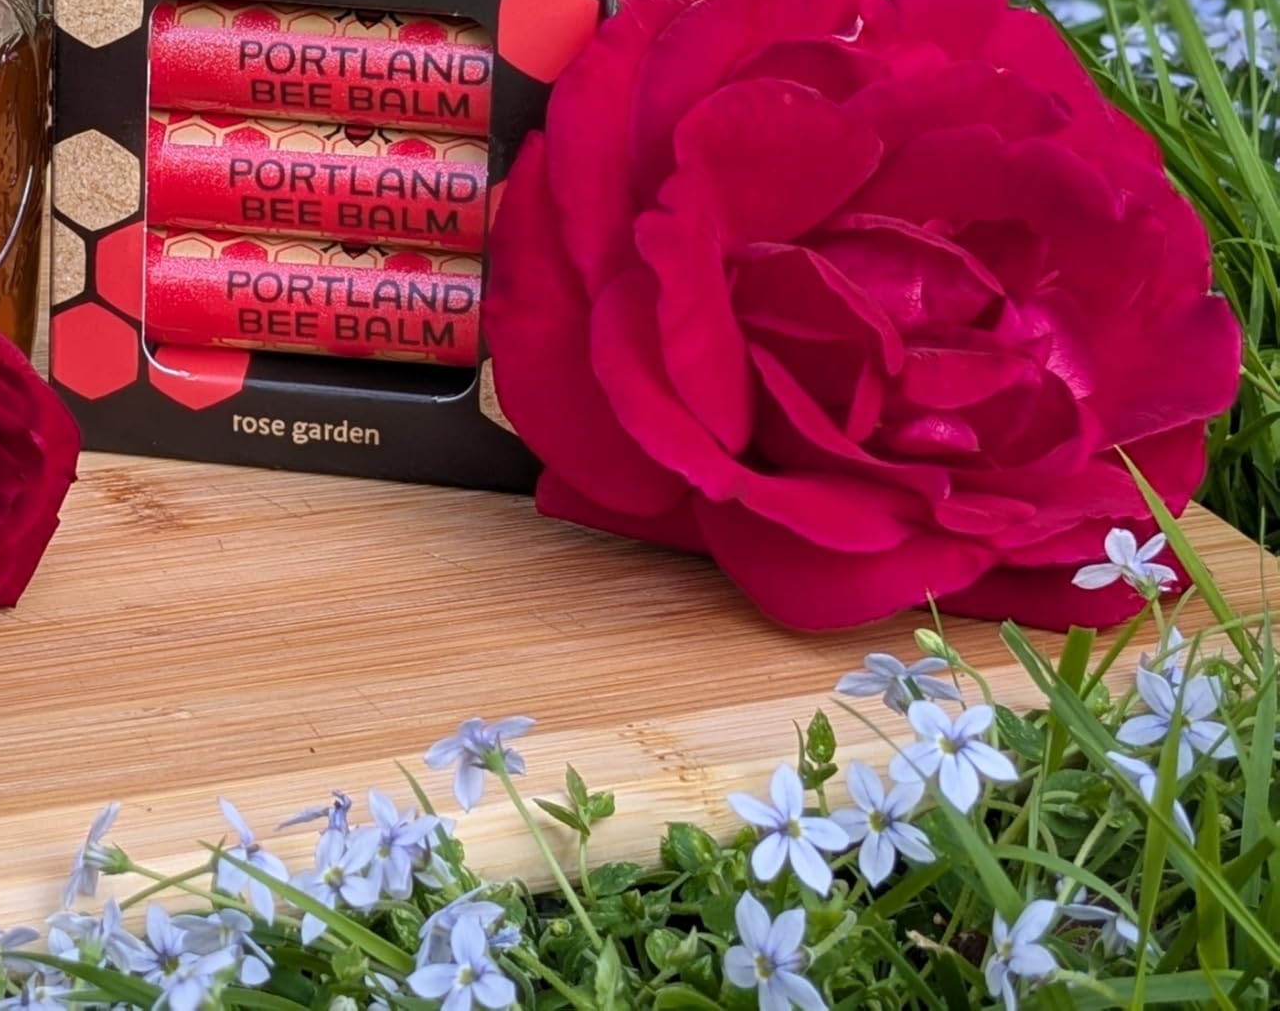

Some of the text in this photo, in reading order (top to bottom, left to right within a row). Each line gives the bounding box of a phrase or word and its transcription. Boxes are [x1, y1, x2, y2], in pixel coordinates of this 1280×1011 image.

[239, 40, 491, 86] PORTLAND
[251, 79, 471, 118] BEE BALM
[229, 158, 479, 203] PORTLAND
[241, 196, 459, 235] BEE BALM
[225, 270, 475, 315] PORTLAND
[238, 307, 456, 348] BEE BALM
[232, 413, 380, 445] rose garden
